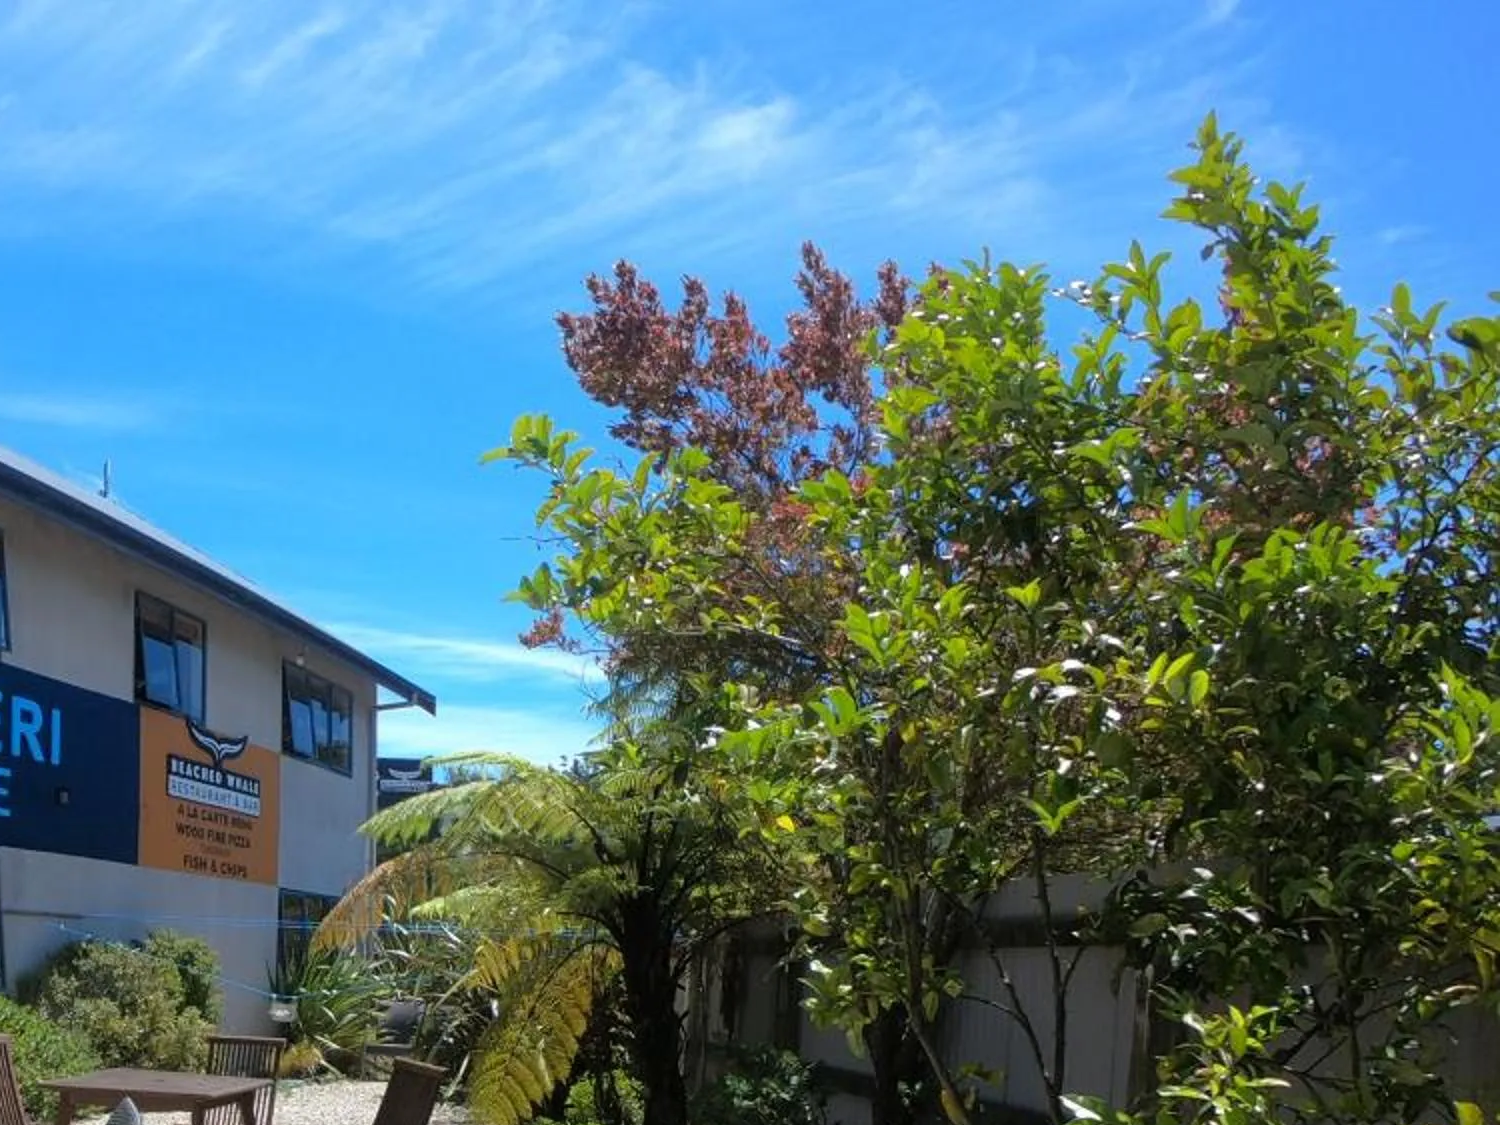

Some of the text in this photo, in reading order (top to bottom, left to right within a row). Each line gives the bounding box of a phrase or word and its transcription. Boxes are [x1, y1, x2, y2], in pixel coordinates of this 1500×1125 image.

[171, 757, 259, 796] BEACHED WHALE
[177, 803, 185, 817] A
[187, 804, 198, 818] LA
[201, 808, 229, 825] CARTE
[175, 821, 205, 839] WOOD
[228, 833, 251, 849] PIZZA
[183, 853, 248, 879] FISH & CHIPS
